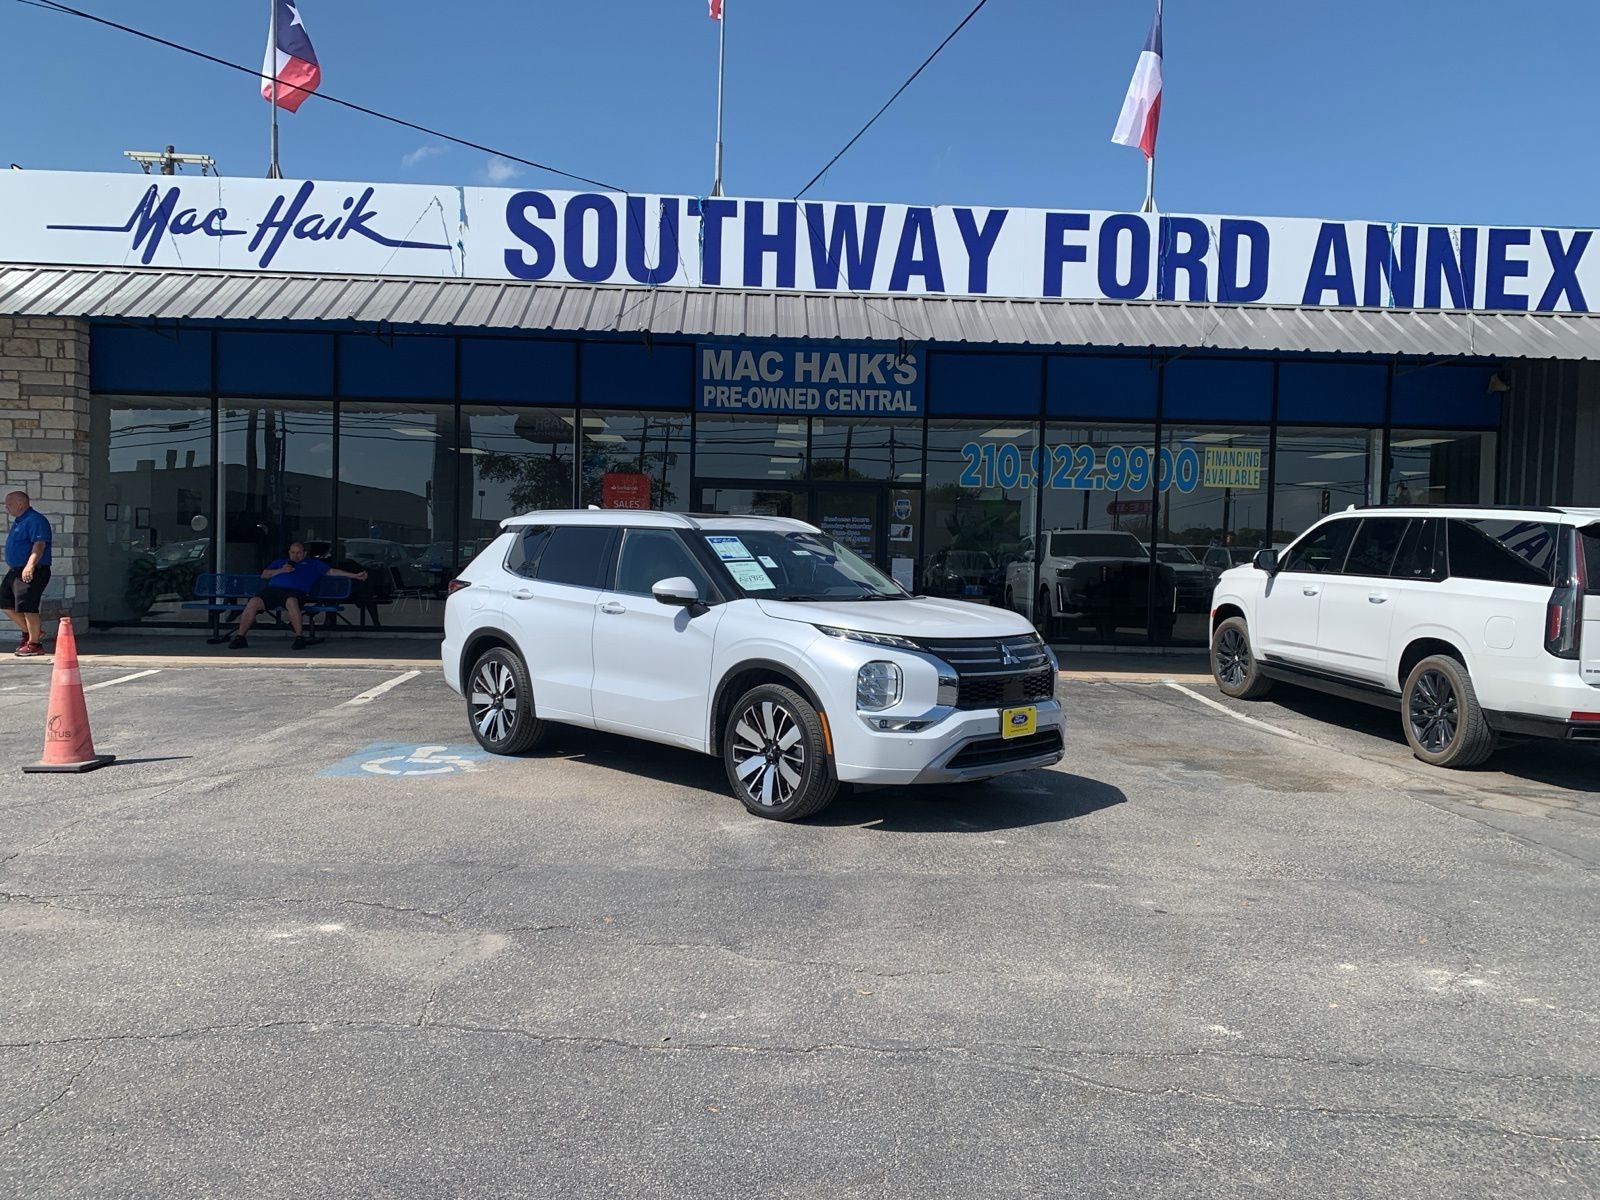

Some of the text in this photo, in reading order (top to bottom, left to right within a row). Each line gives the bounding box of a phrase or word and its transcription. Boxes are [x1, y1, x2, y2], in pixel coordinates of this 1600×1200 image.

[47, 180, 452, 269] Mac Haik
[504, 190, 1592, 312] SOUTHWAY FORD ANNEX
[702, 350, 918, 385] MAC HAIK'S
[703, 386, 917, 412] PRE-OWNED CENTRAL
[959, 442, 1200, 494] 210.922.9900
[1206, 450, 1260, 467] FINANCING
[1205, 468, 1259, 486] AVAILABLE
[613, 500, 640, 509] SALES
